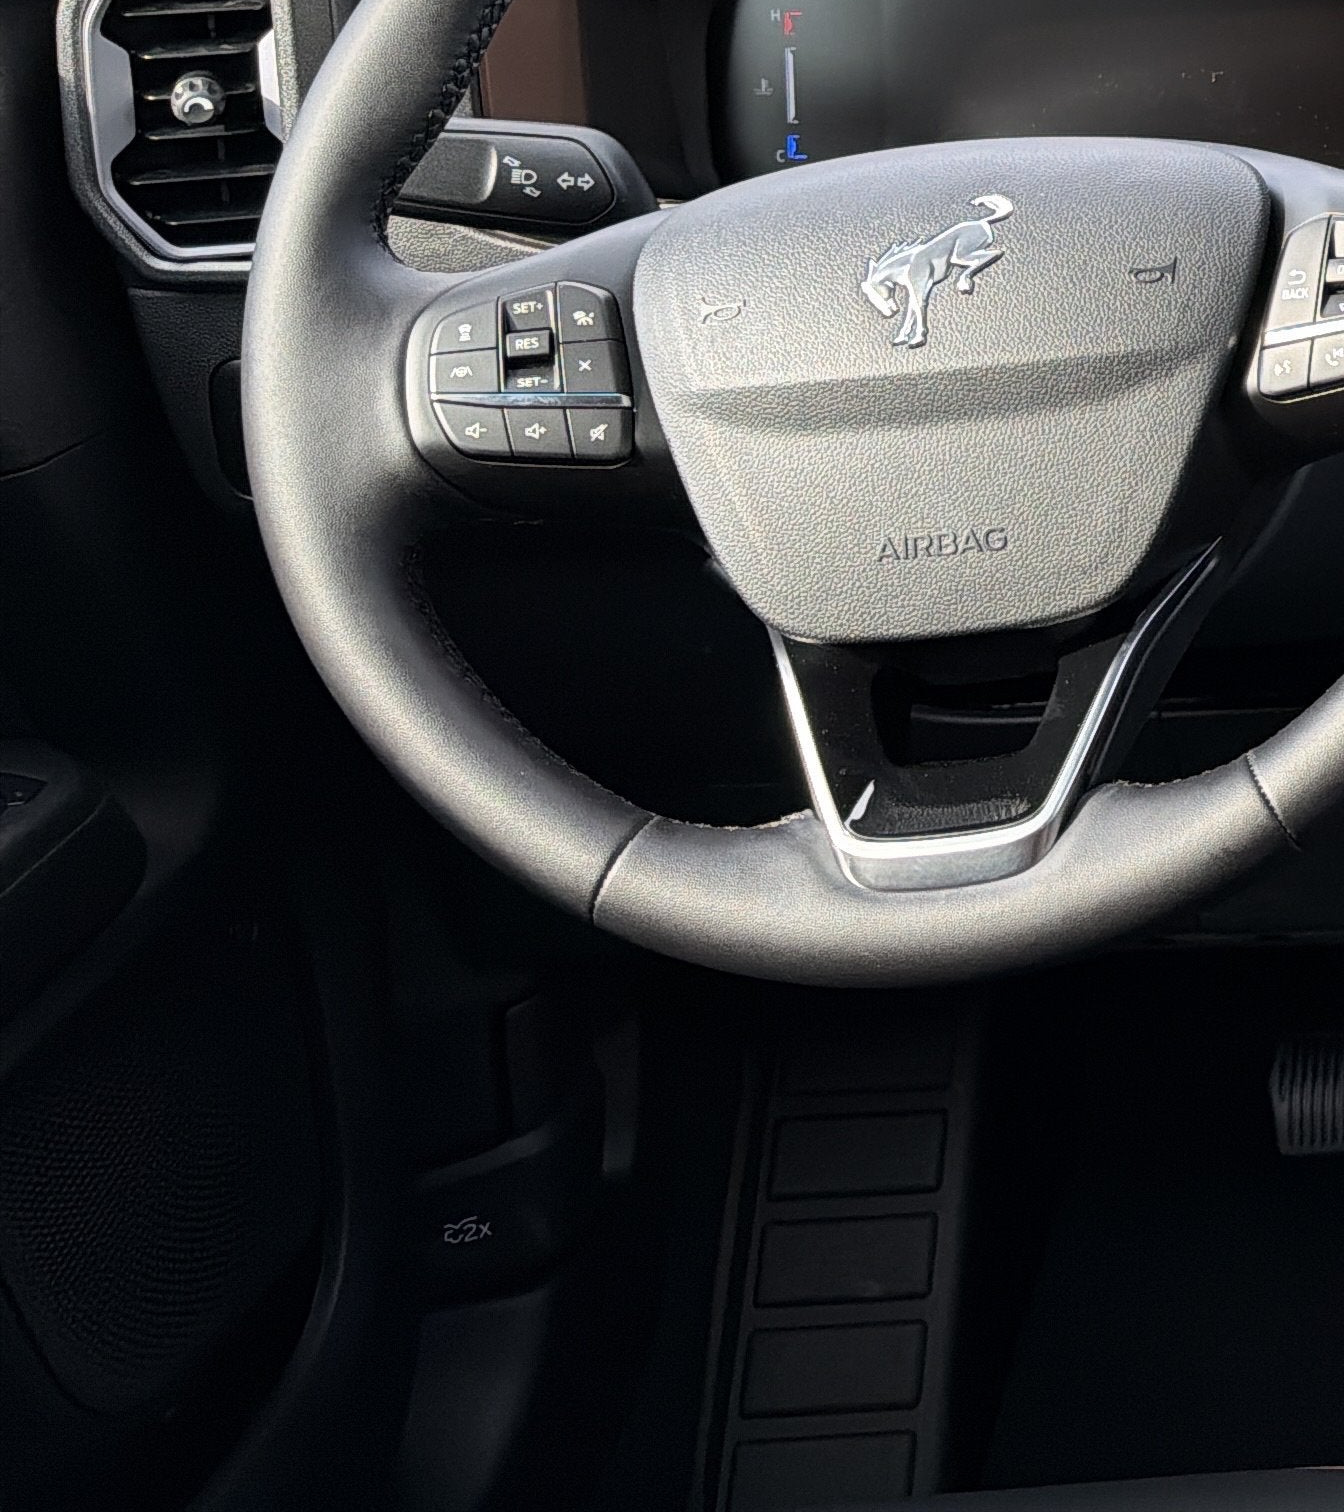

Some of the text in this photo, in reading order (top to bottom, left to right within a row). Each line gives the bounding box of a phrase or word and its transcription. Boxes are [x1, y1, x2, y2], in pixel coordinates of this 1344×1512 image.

[770, 8, 781, 21] H
[776, 150, 786, 163] C
[1281, 288, 1310, 301] BACK
[512, 301, 544, 316] SET+
[515, 337, 540, 351] RES
[876, 527, 1009, 563] AIRBAG
